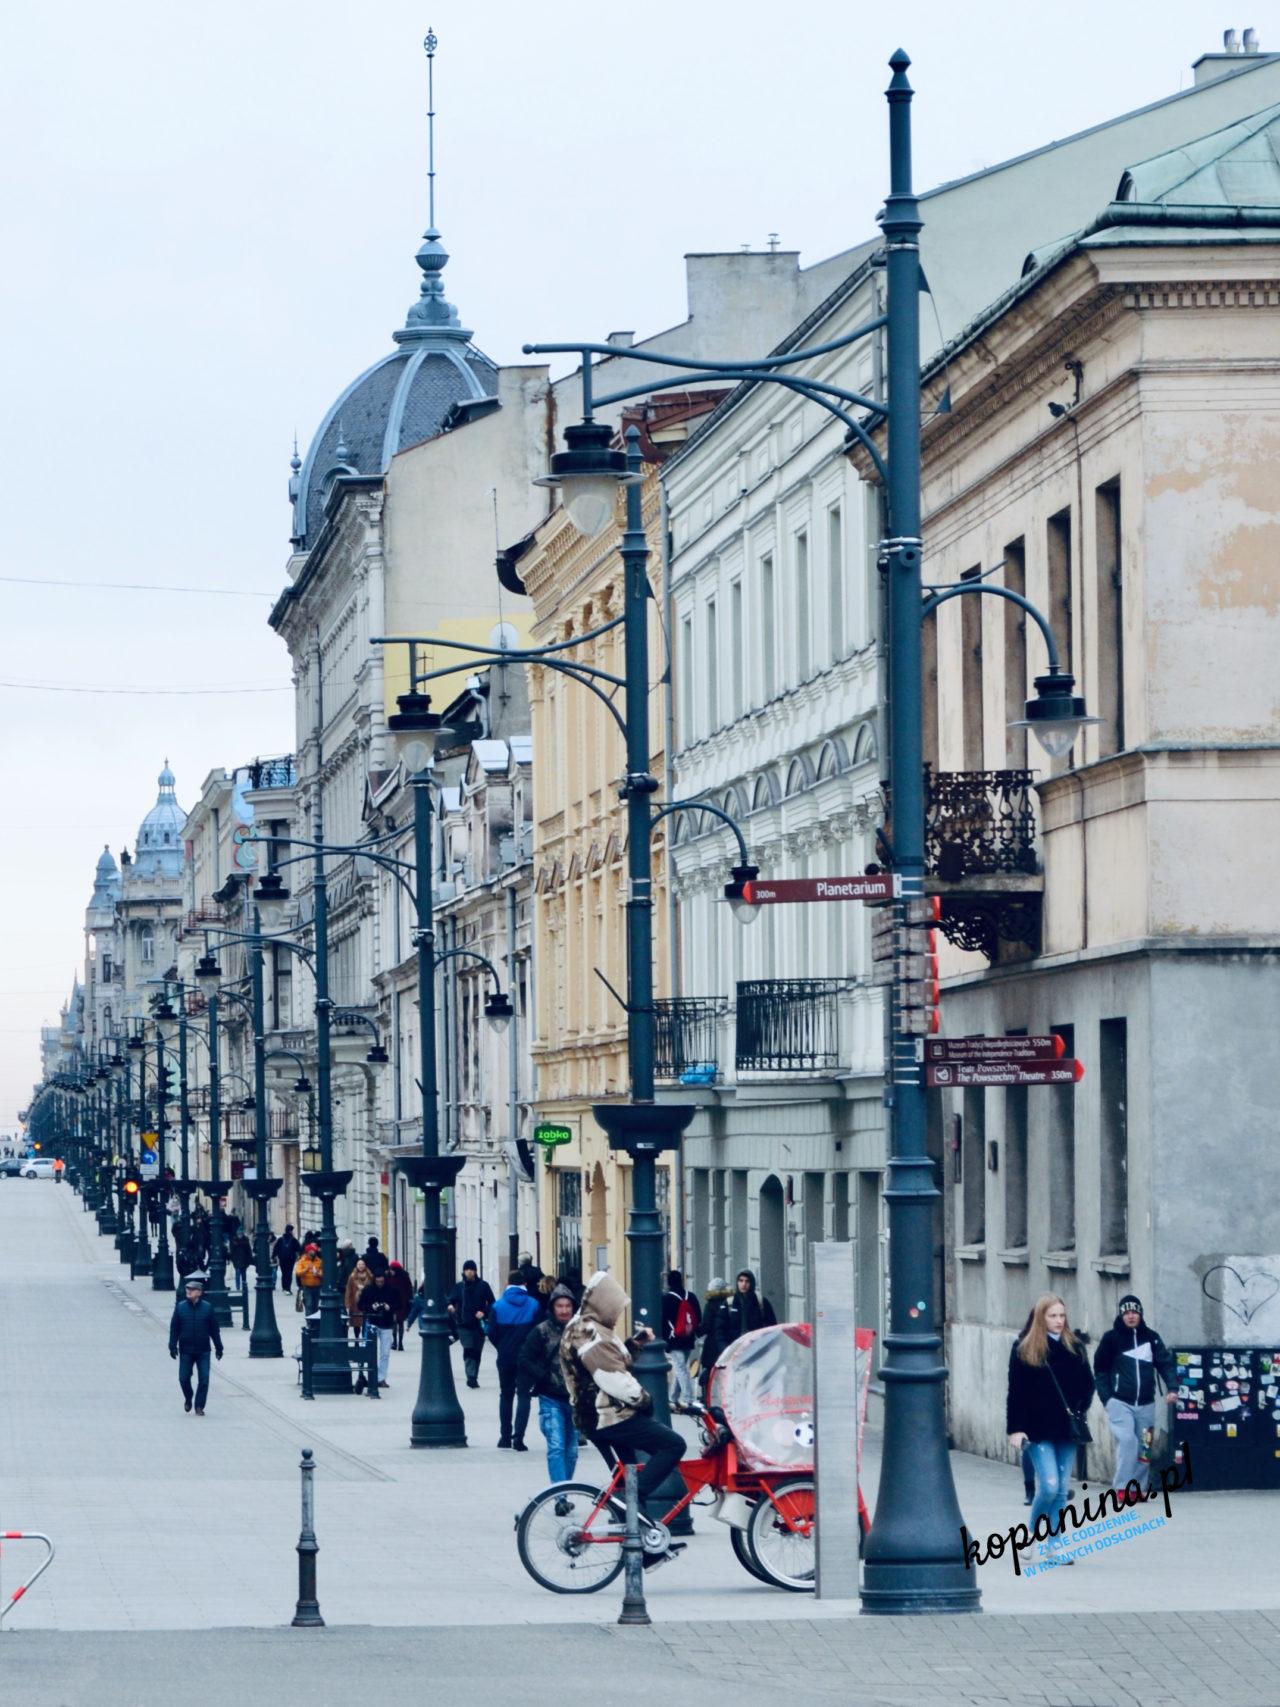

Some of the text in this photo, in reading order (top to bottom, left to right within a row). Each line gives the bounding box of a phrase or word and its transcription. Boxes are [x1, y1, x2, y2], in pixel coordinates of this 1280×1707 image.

[816, 881, 886, 896] Planetarium
[755, 890, 777, 900] 300m
[1032, 1039, 1052, 1047] 550m
[957, 1062, 1022, 1073] Teatr Powszechny
[957, 1071, 1046, 1083] The Powszechny Theatre
[1051, 1070, 1073, 1079] 350m
